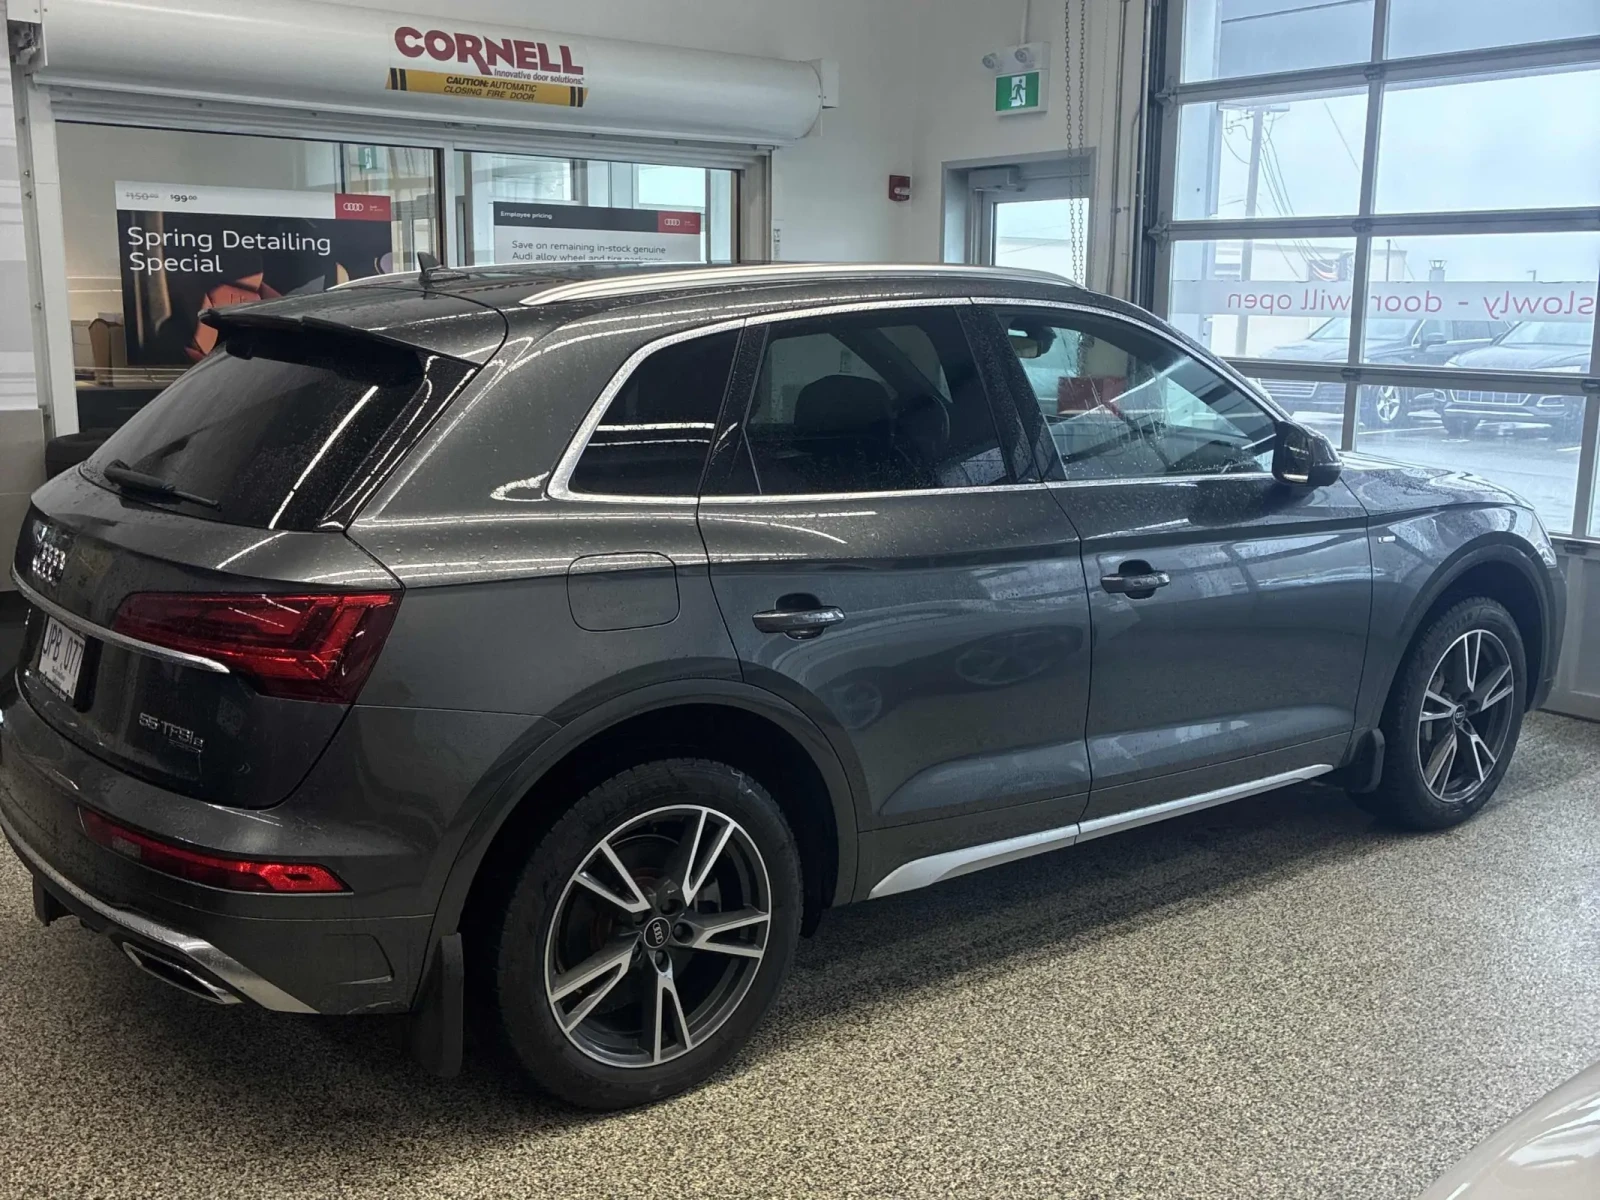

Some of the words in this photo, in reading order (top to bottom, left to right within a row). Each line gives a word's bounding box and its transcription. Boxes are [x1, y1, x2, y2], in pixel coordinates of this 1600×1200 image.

[394, 26, 584, 76] CORNELL
[446, 76, 489, 88] CAUTION:
[489, 80, 537, 92] AUTOMATIC
[532, 72, 549, 82] door
[443, 86, 482, 97] CLOSING
[486, 90, 506, 98] FIRE
[509, 91, 535, 101] DOOR
[500, 210, 531, 219] Employee
[531, 212, 553, 220] pricing
[127, 226, 212, 252] Spring
[222, 230, 331, 256] Detailing
[511, 240, 534, 250] Save
[550, 242, 595, 253] remaining
[597, 244, 631, 253] in-stock
[633, 245, 666, 255] genuine
[129, 251, 223, 275] Special
[512, 252, 533, 261] Audi
[535, 252, 558, 262] alloy
[559, 253, 586, 261] wheel
[138, 712, 159, 730] 55
